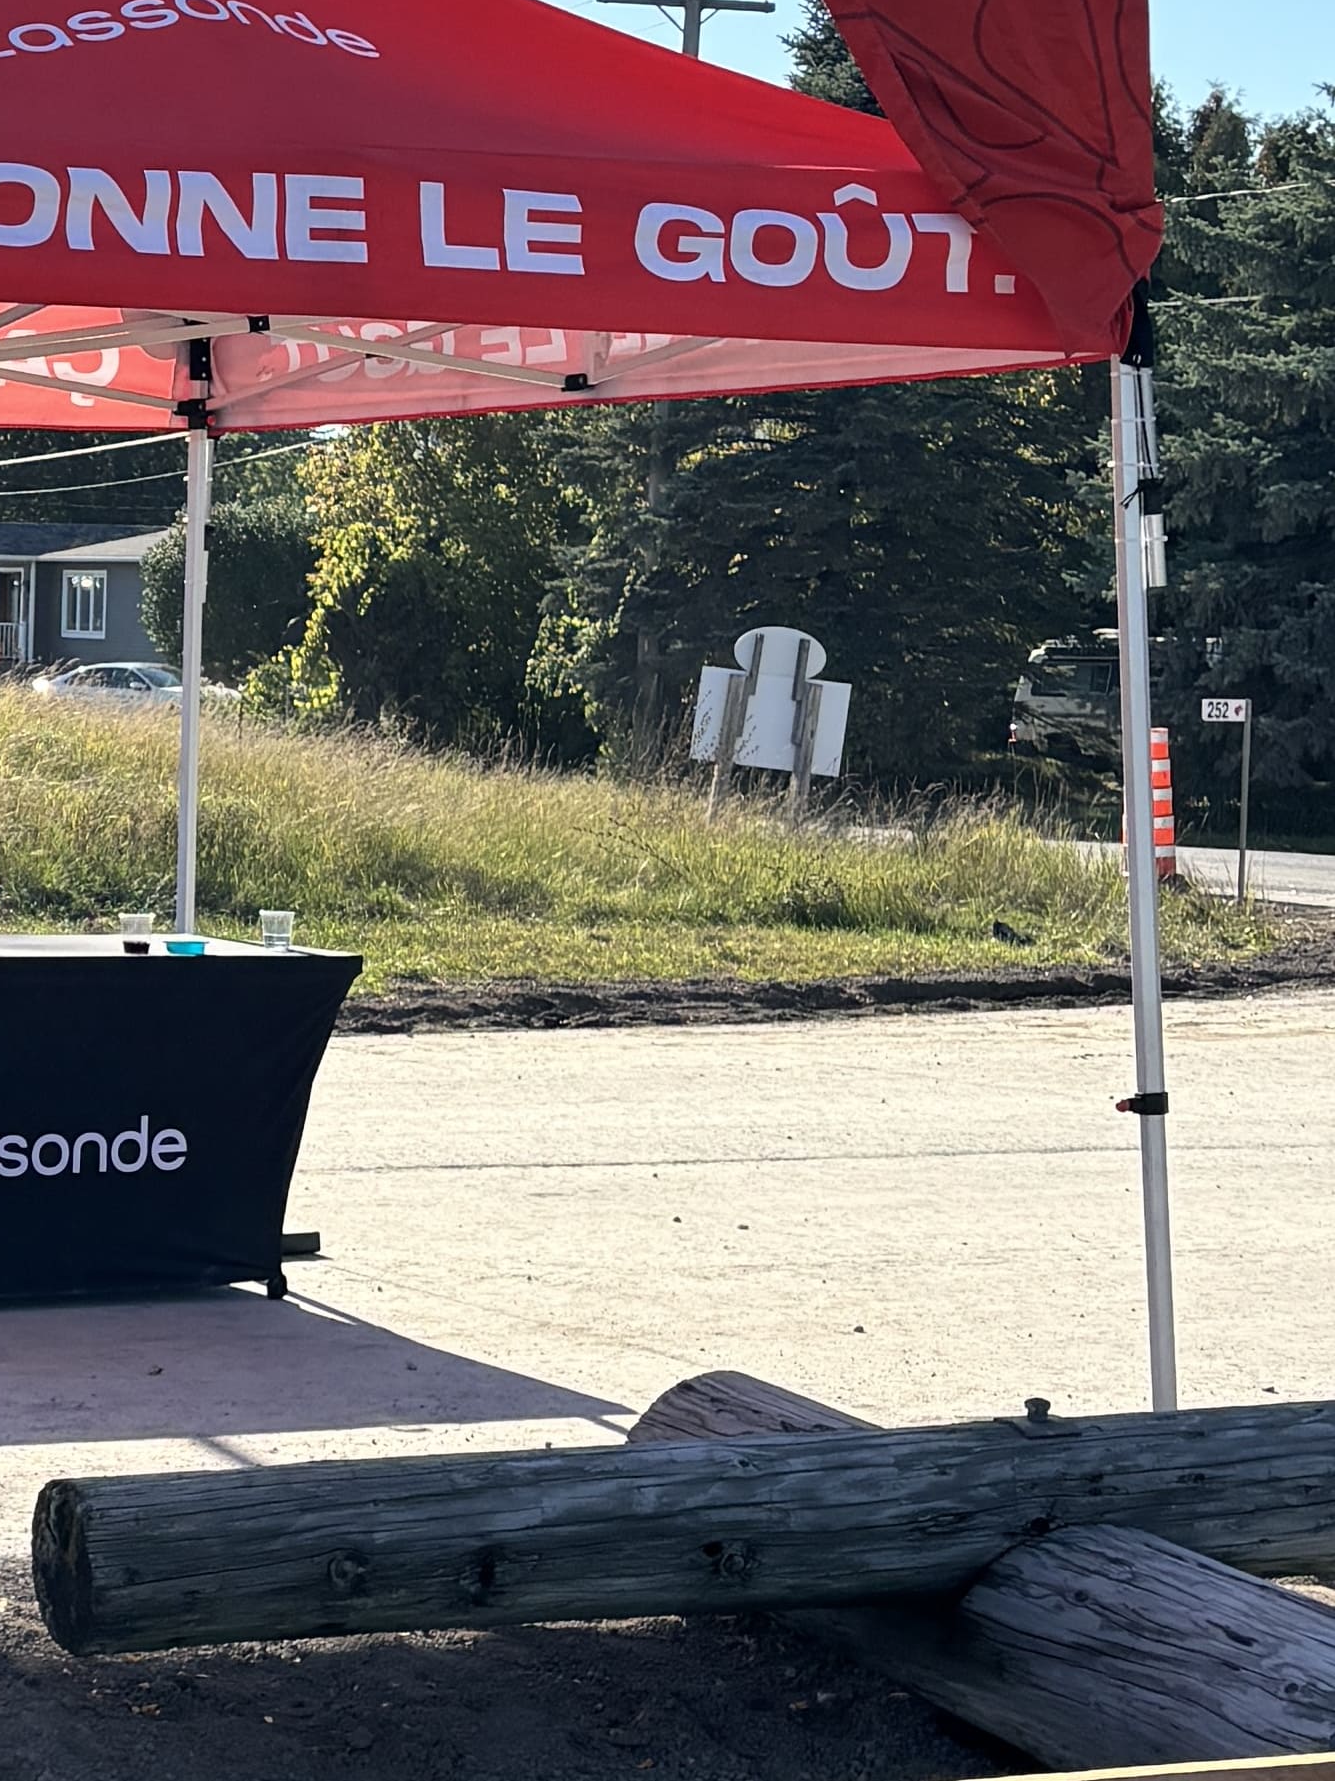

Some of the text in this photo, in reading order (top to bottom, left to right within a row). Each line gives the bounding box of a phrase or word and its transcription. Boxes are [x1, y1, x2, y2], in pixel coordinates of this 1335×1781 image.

[419, 180, 585, 276] LE
[634, 182, 1017, 296] GOÛT.
[1207, 701, 1229, 718] 252
